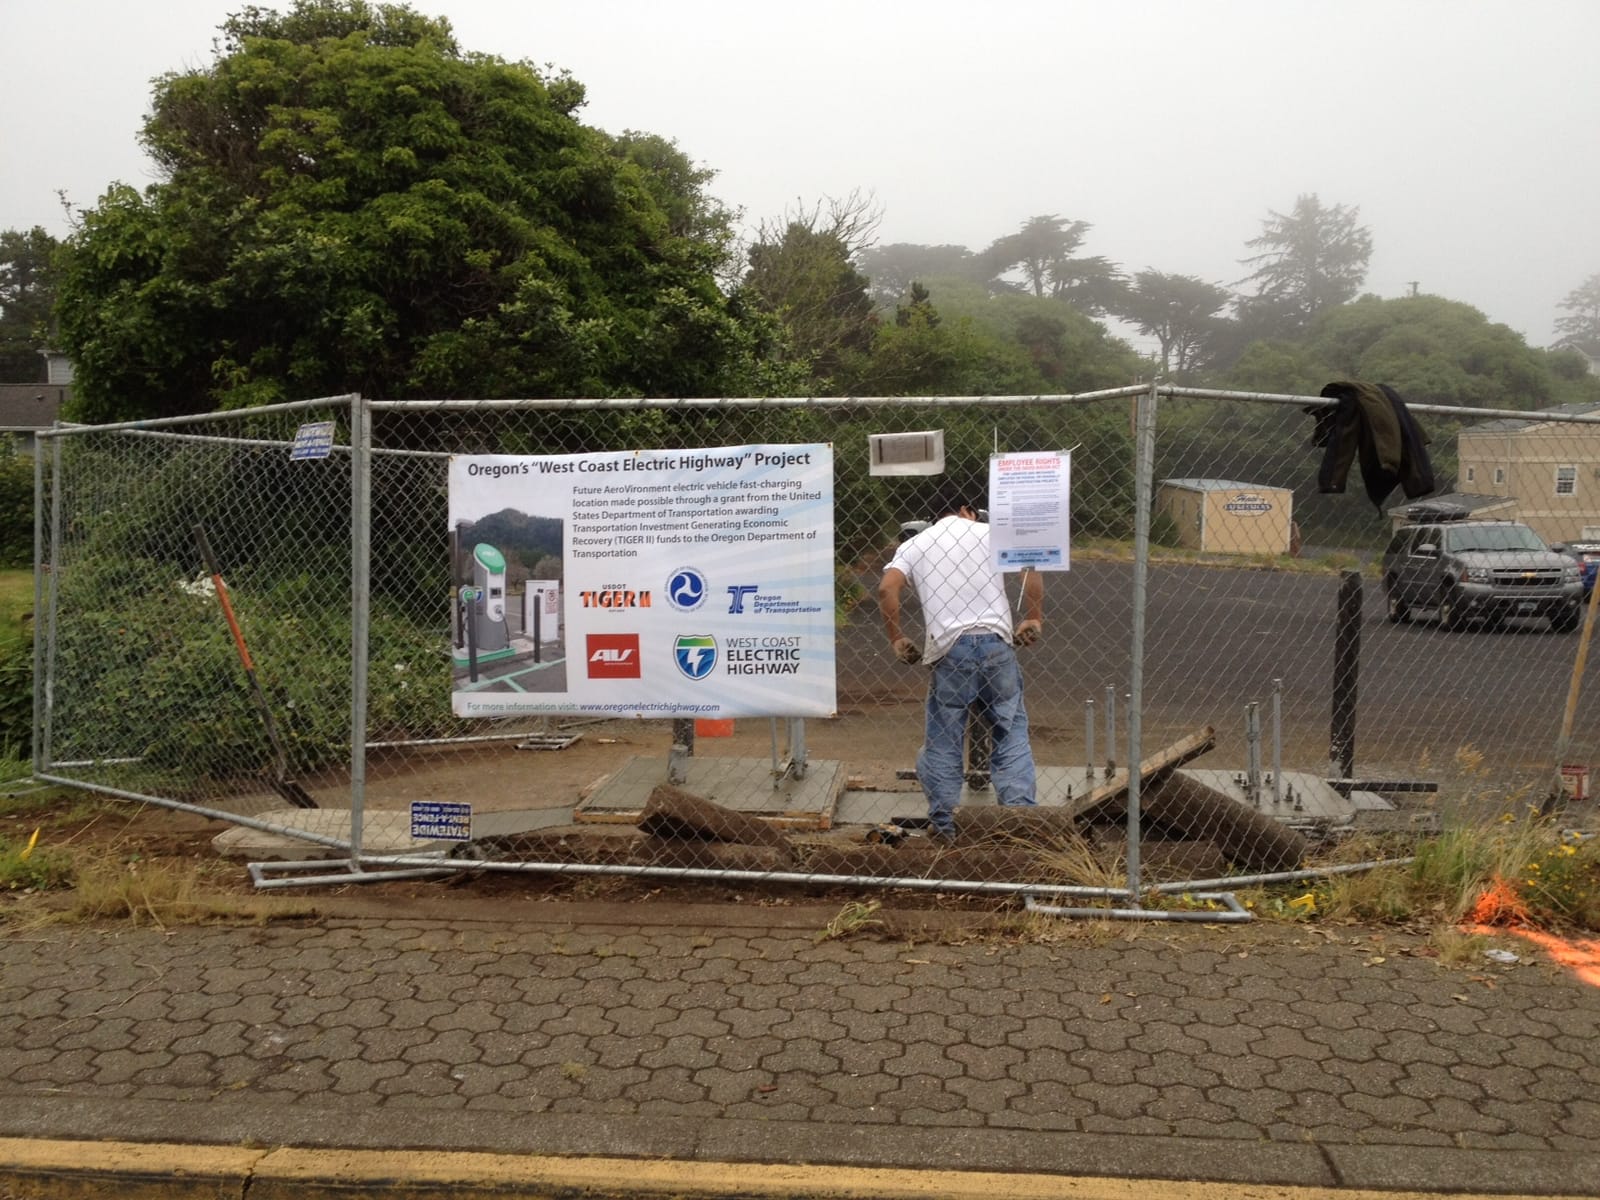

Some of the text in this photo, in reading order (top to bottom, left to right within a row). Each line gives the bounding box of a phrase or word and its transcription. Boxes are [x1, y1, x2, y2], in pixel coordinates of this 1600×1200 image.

[578, 460, 619, 473] Coast
[623, 456, 676, 472] Electric
[755, 453, 811, 469] Project
[998, 458, 1061, 467] EMPLOYEE RIGHTS
[572, 478, 802, 495] Future AeroVironment electric vehicle fast-charging
[572, 498, 609, 508] location
[610, 498, 636, 507] made
[637, 496, 674, 508] possible
[676, 495, 712, 506] through
[720, 494, 745, 505] grant
[747, 492, 770, 502] from
[771, 492, 787, 502] the
[789, 491, 822, 501] United
[572, 506, 779, 521] States Department of Transportation awarding
[572, 518, 788, 535] Transportation Investment Generating Economic
[572, 530, 817, 548] Recovery (TIGER II) funds to the Oregon Department of
[572, 549, 638, 561] Transportation
[579, 590, 651, 608] TIGER II
[753, 594, 782, 602] Oregon
[765, 606, 822, 615] Transportation
[726, 636, 801, 648] WEST COAST
[727, 649, 801, 662] ELECTRIC
[727, 662, 800, 675] HIGHWAY
[467, 702, 481, 711] For
[505, 702, 557, 711] information
[559, 702, 579, 711] visit:
[580, 701, 720, 714] www.oregonelectrichighway.com
[412, 824, 469, 837] STATEWIDE
